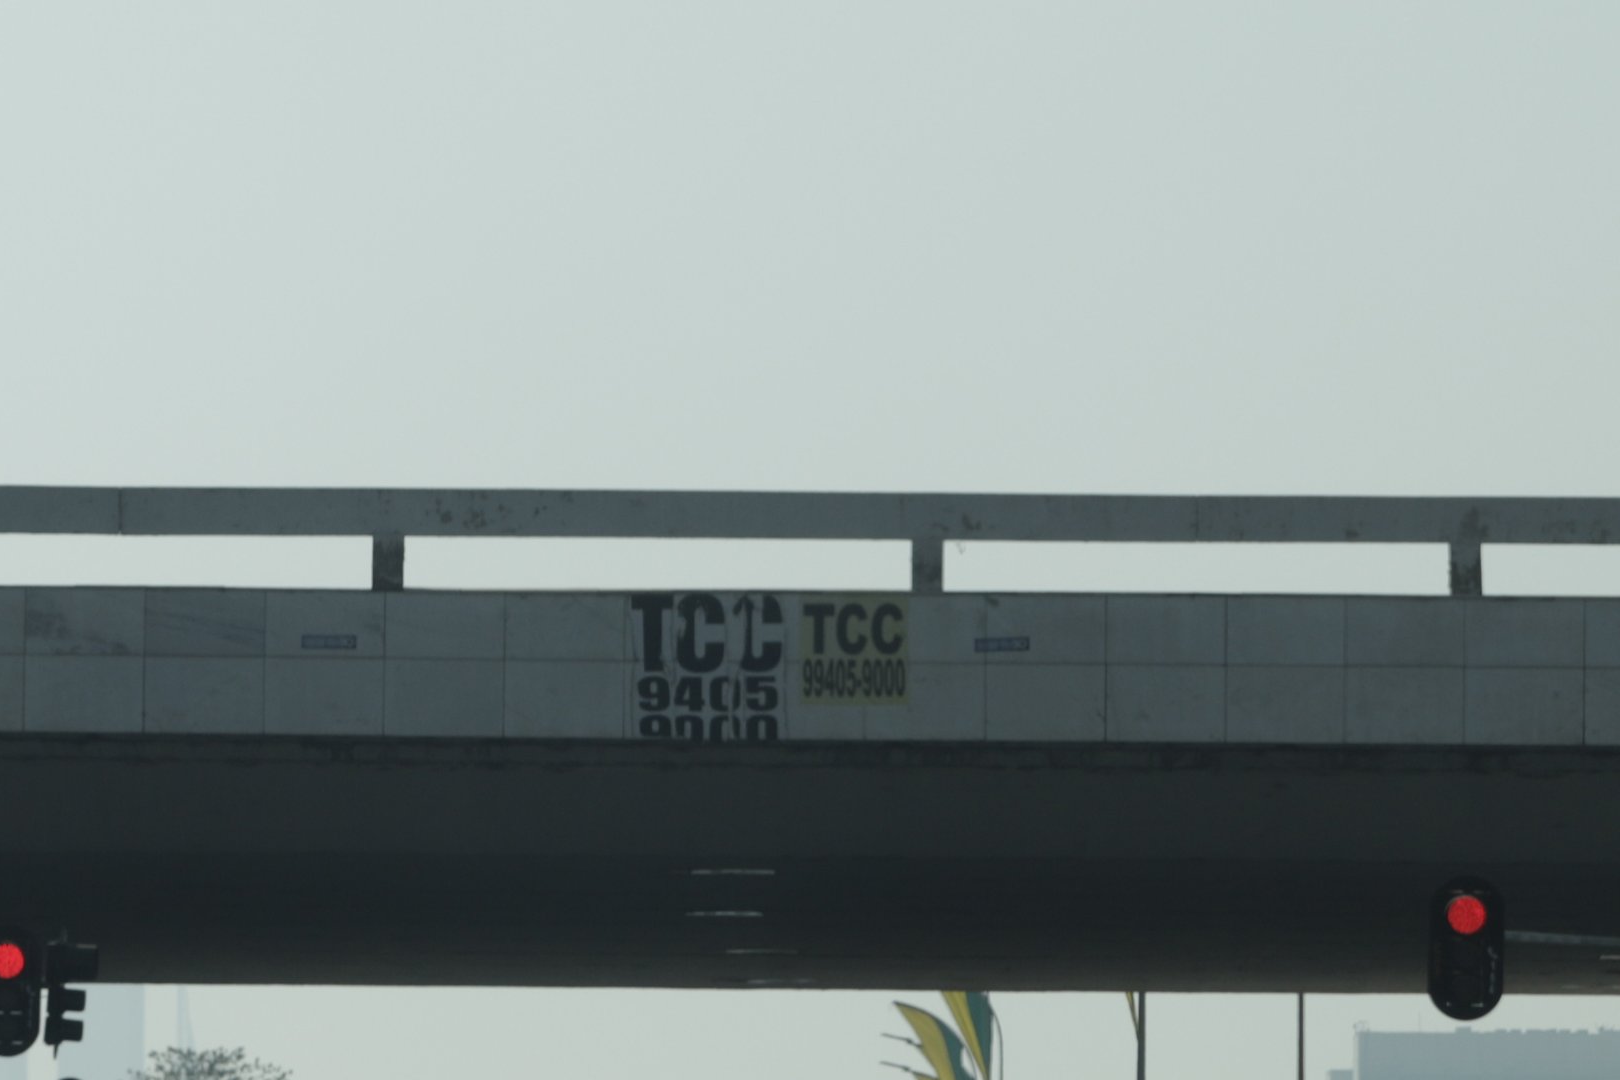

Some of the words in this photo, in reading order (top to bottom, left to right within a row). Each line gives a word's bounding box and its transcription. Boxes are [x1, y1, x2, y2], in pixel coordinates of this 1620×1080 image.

[631, 593, 782, 673] TCC
[802, 603, 904, 655] TCC
[637, 676, 778, 712] 9405
[802, 658, 906, 698] 99405-9000
